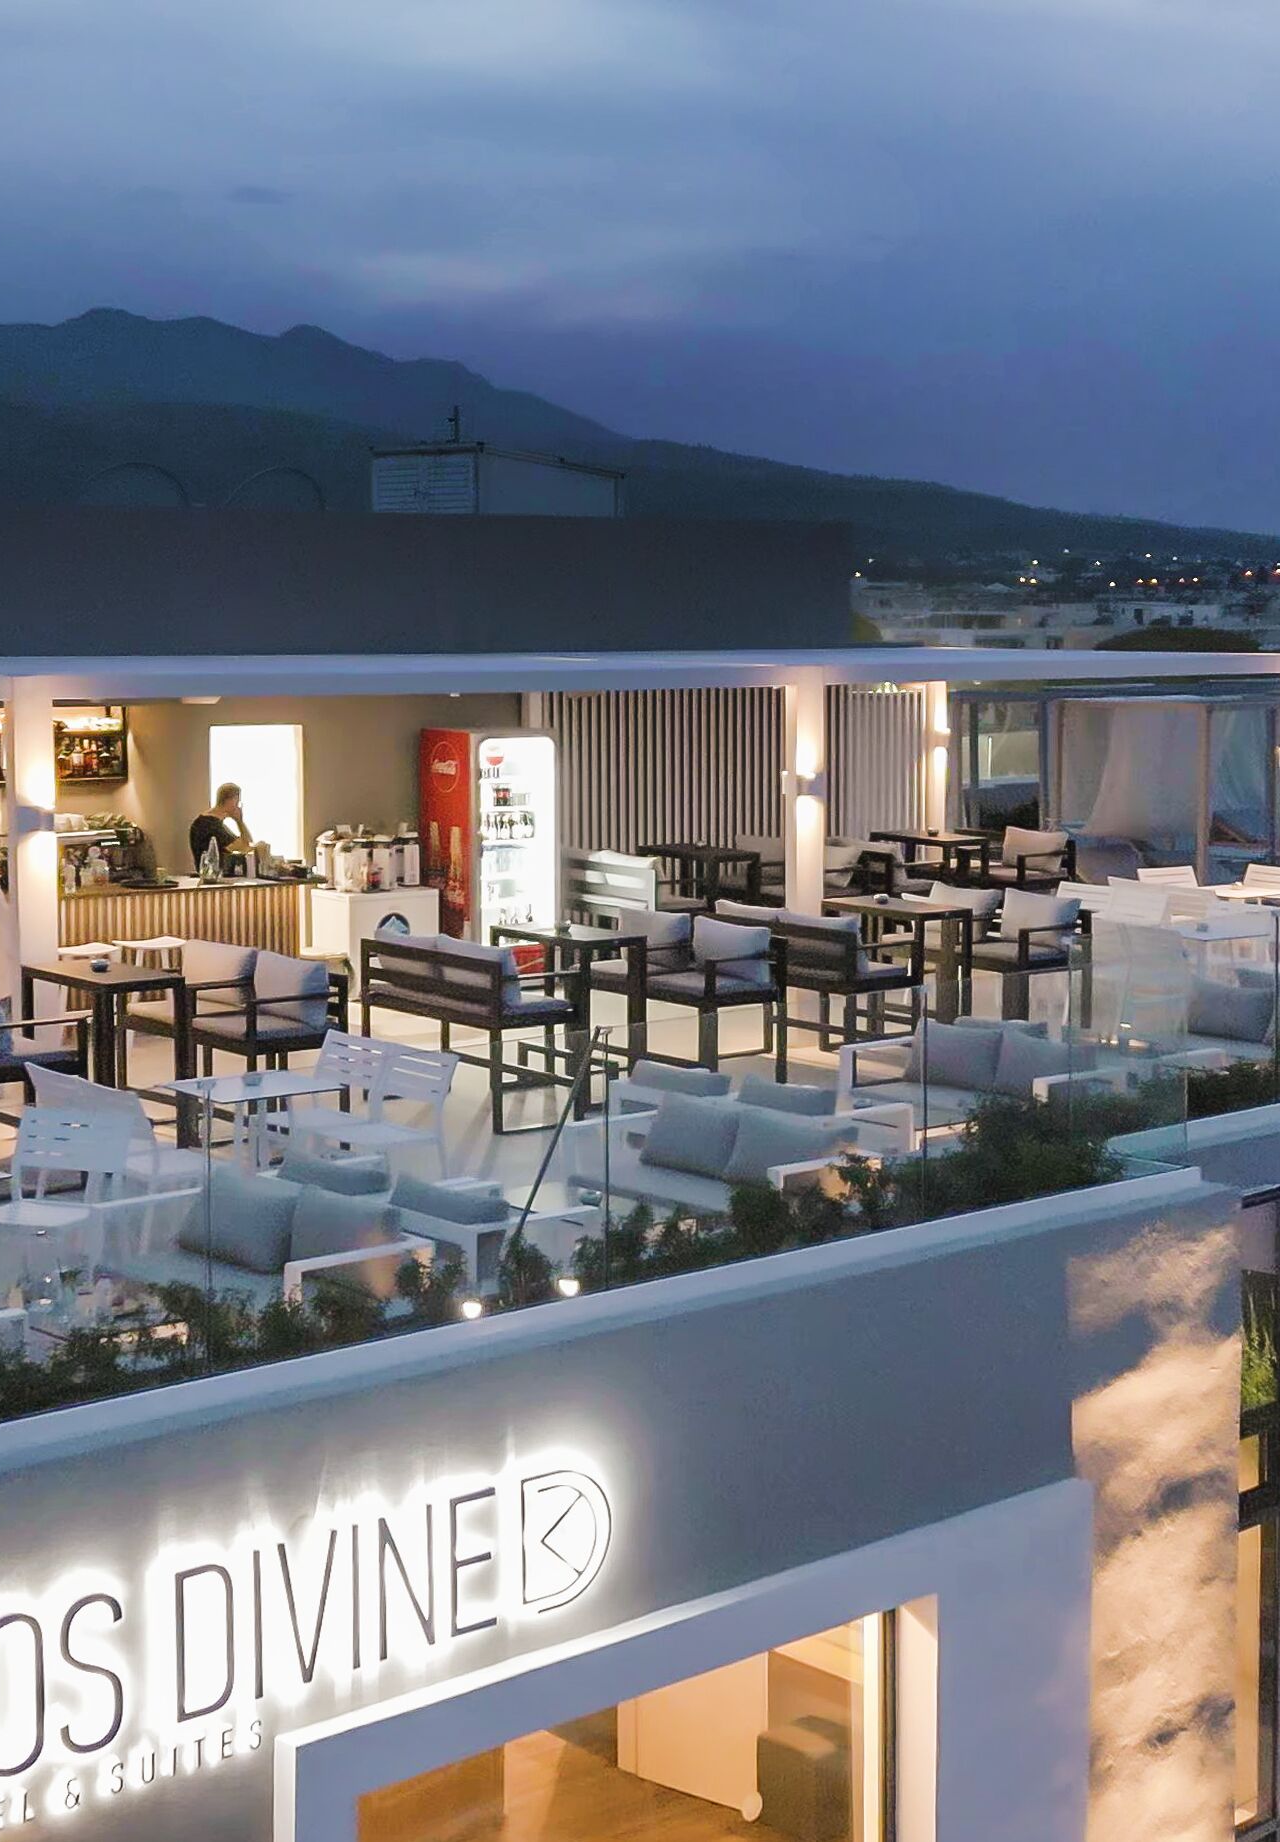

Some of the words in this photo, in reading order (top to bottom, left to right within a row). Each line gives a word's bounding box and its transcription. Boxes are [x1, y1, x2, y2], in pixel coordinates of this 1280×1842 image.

[174, 1486, 498, 1724] DIVINE
[64, 1777, 81, 1810] &
[110, 1719, 263, 1795] SUITES
